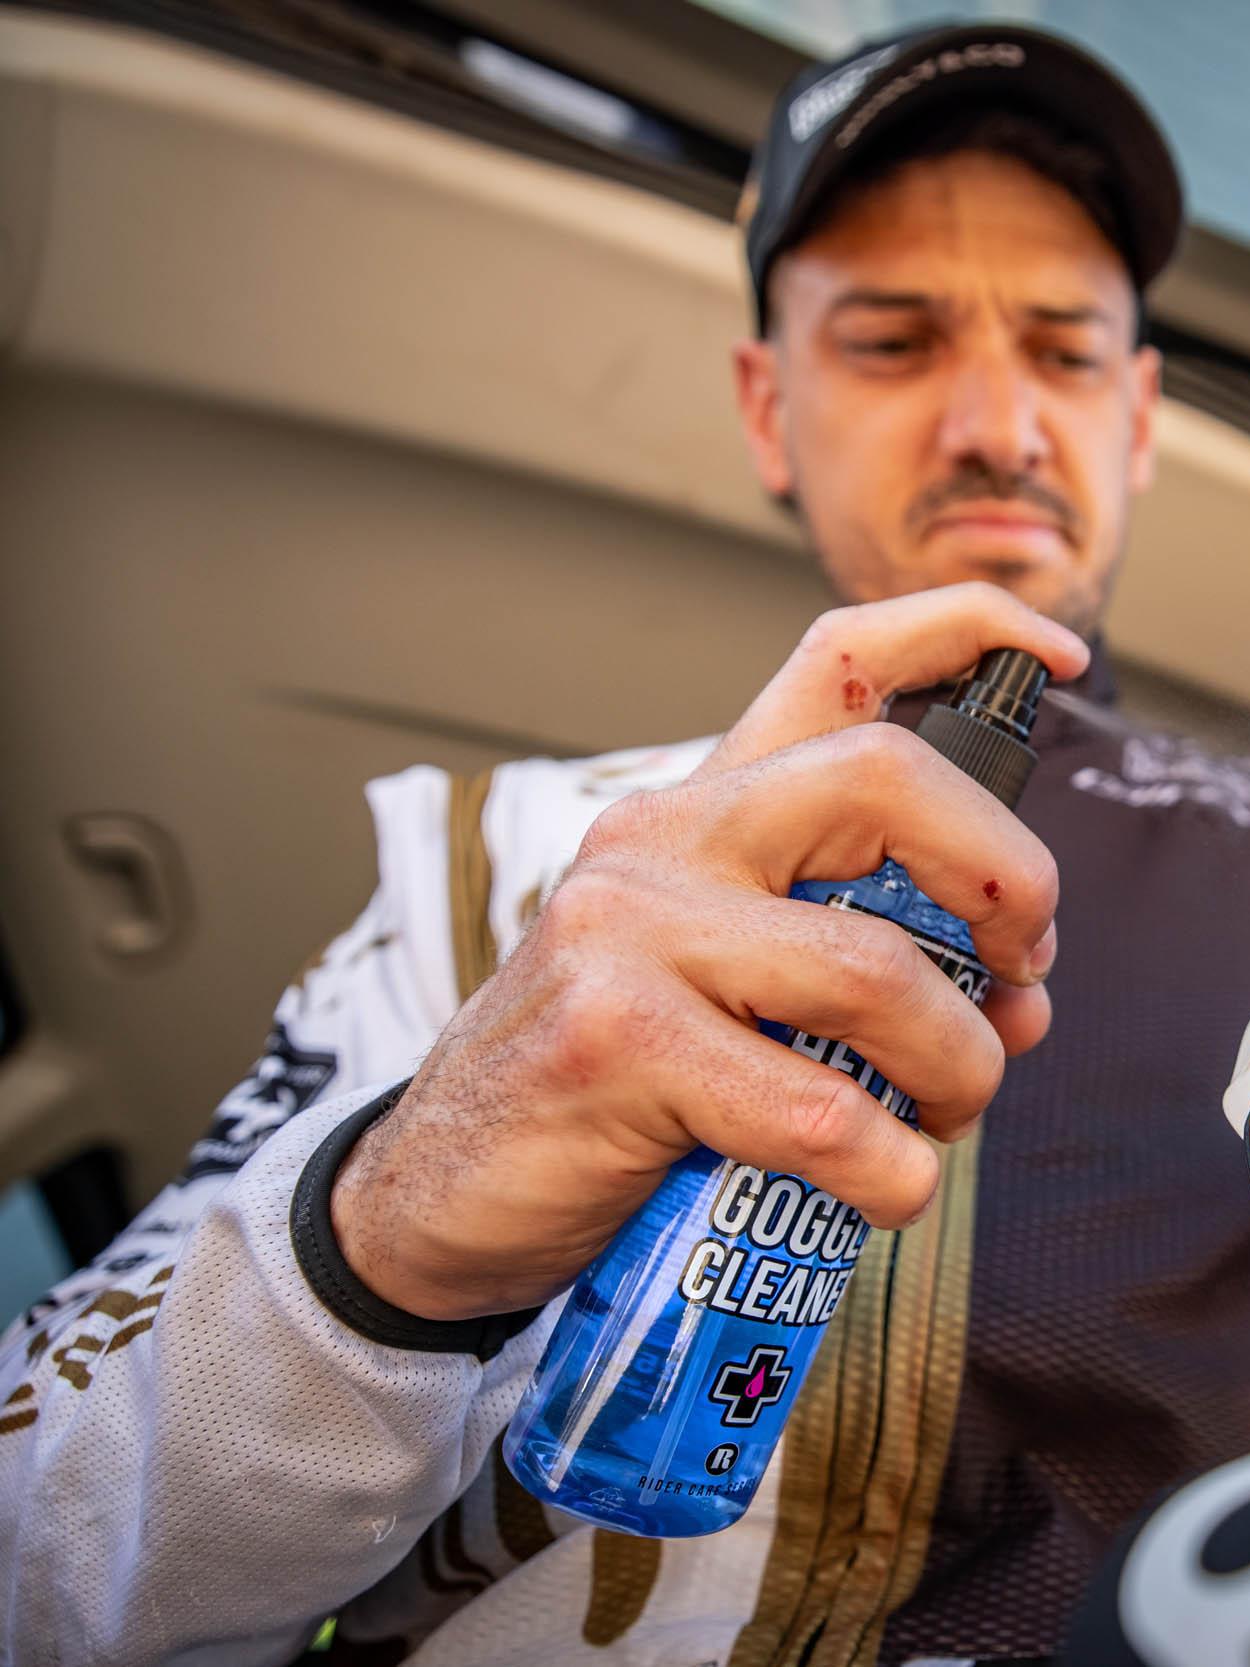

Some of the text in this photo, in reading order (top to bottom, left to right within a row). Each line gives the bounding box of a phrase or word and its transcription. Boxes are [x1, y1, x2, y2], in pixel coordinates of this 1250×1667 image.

[708, 1446, 736, 1471] R
[638, 1475, 682, 1495] RIDER
[687, 1482, 721, 1497] CARE
